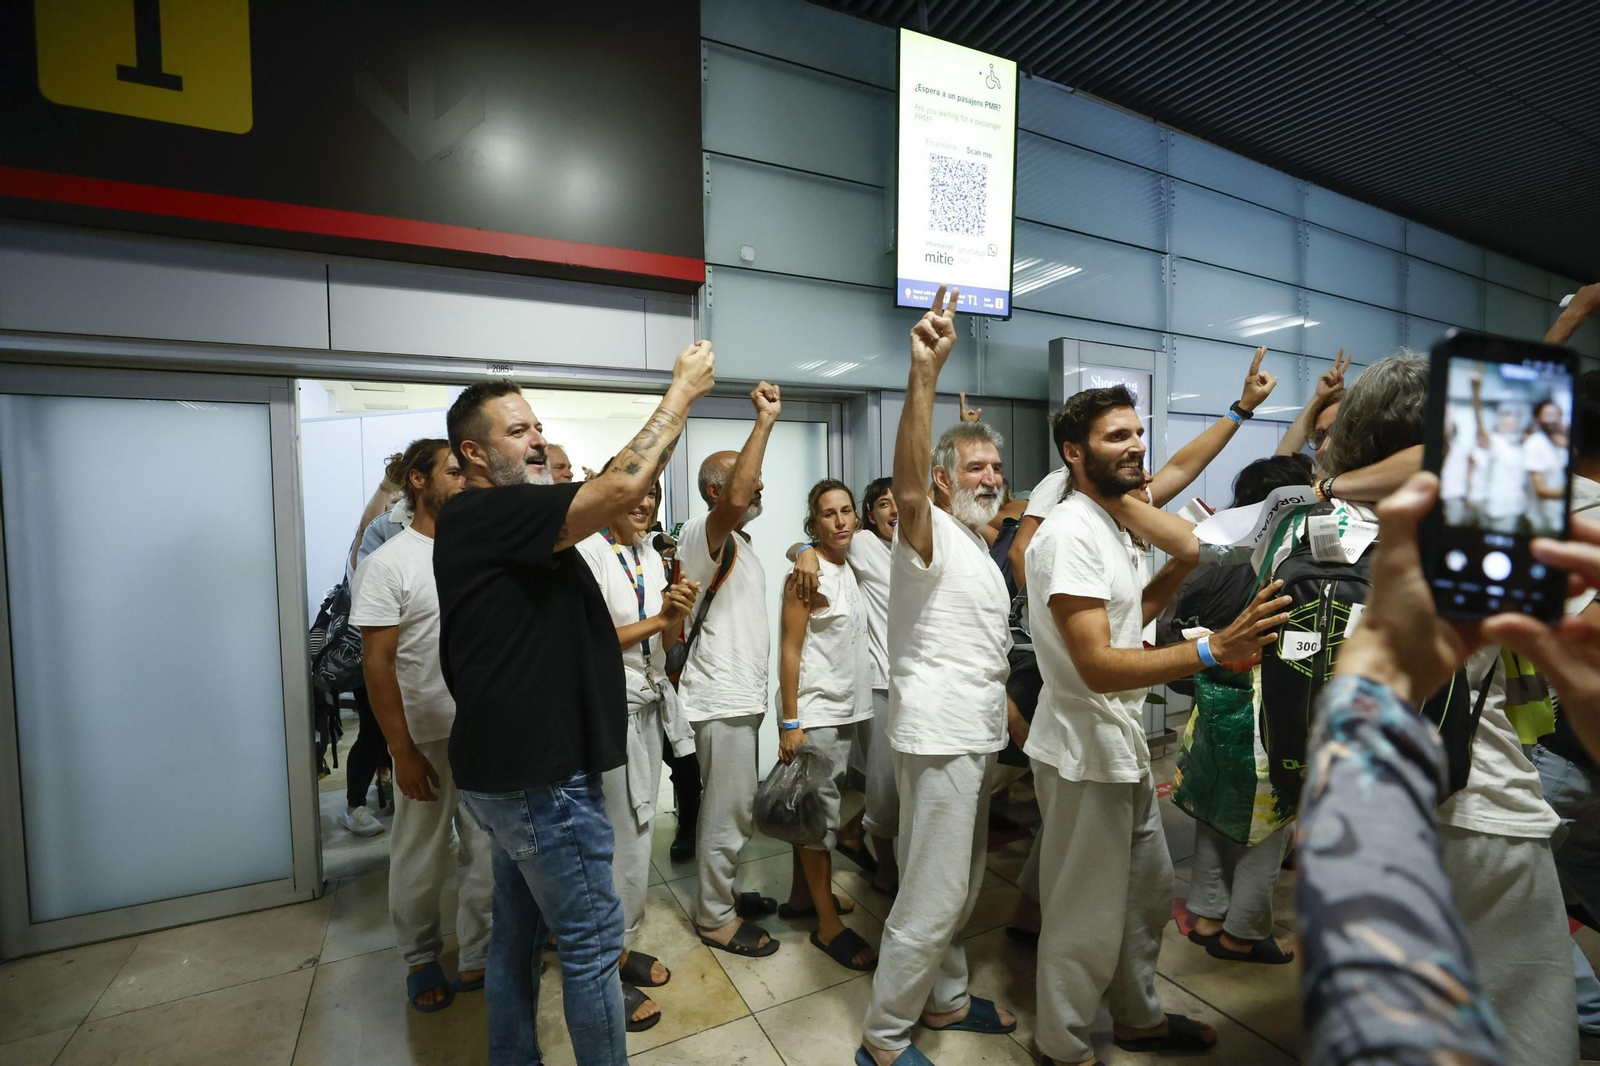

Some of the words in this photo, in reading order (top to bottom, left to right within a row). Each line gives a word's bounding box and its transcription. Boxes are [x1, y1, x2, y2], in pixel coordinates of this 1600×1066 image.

[914, 83, 940, 96] ¿Espera
[957, 95, 983, 107] pasajero
[984, 100, 1001, 112] PMR?
[966, 146, 981, 157] Scan
[982, 150, 992, 159] me
[924, 251, 954, 266] mitie
[967, 294, 978, 306] T1
[1296, 641, 1317, 652] 300
